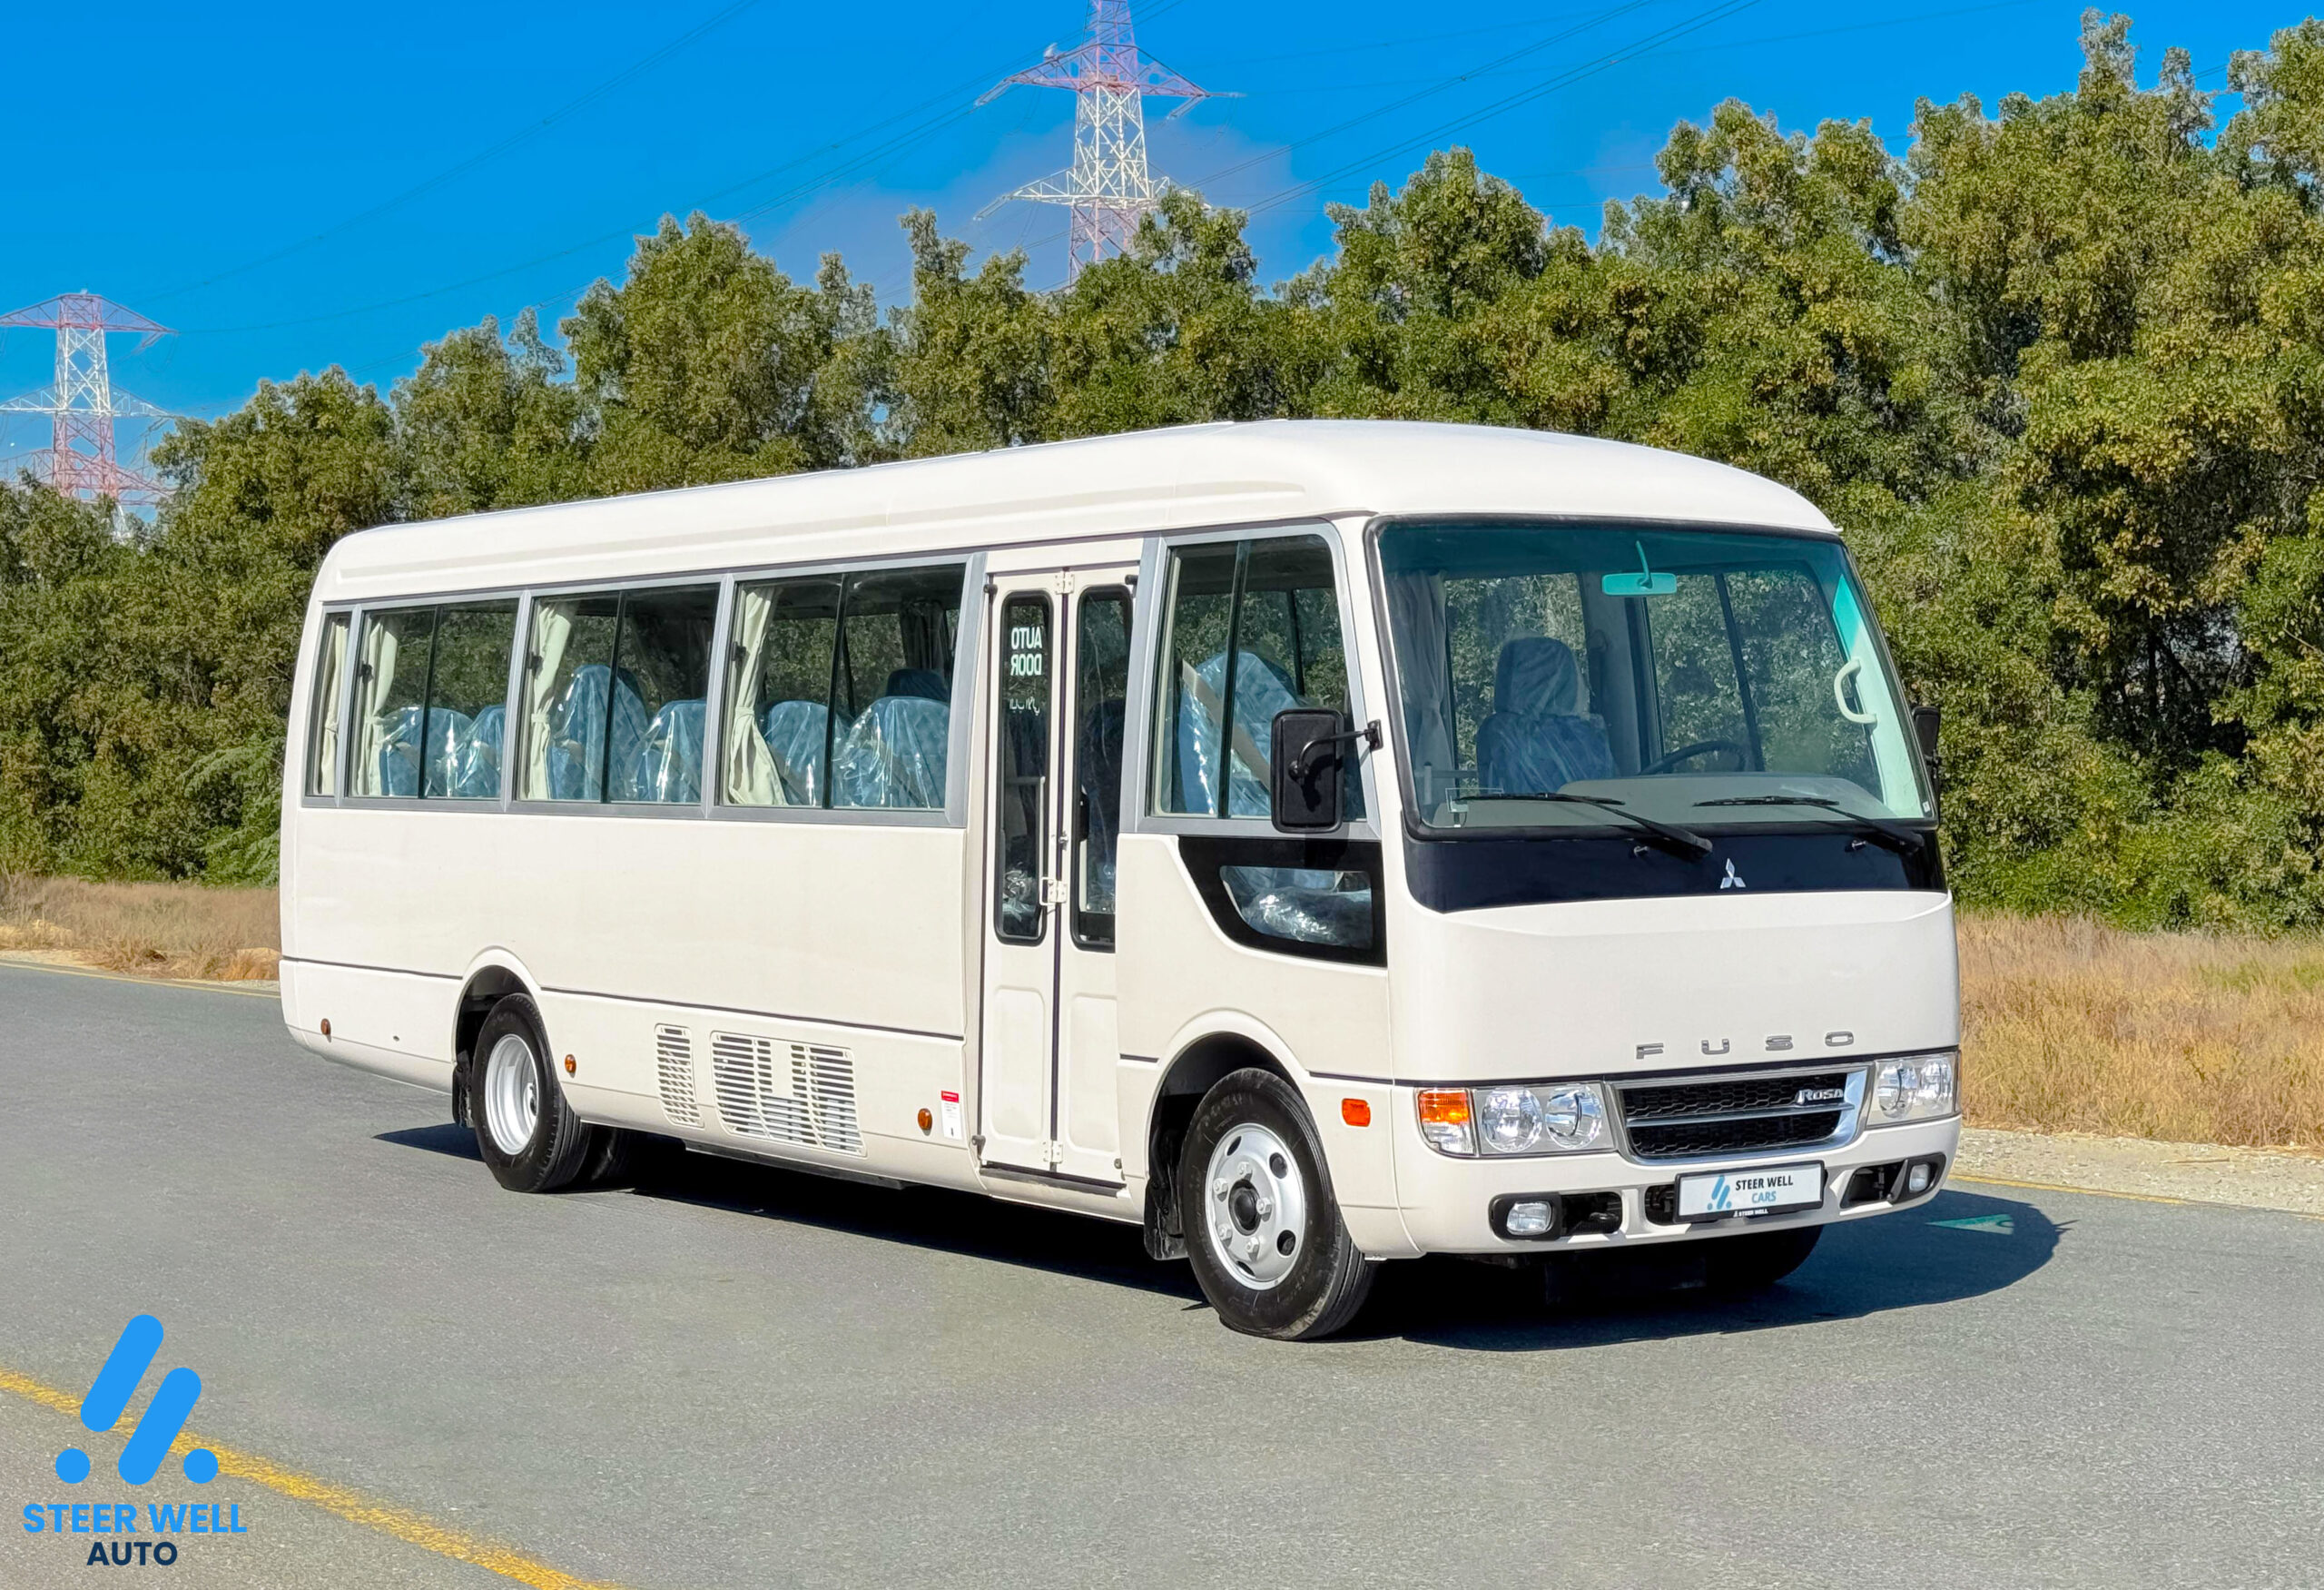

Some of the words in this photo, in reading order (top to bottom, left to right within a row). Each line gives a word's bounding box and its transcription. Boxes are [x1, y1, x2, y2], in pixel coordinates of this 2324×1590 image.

[1636, 1032, 1854, 1060] FUSO
[1736, 1180, 1764, 1190] STEER
[1768, 1175, 1794, 1188] WELL
[1751, 1190, 1777, 1204] CARS
